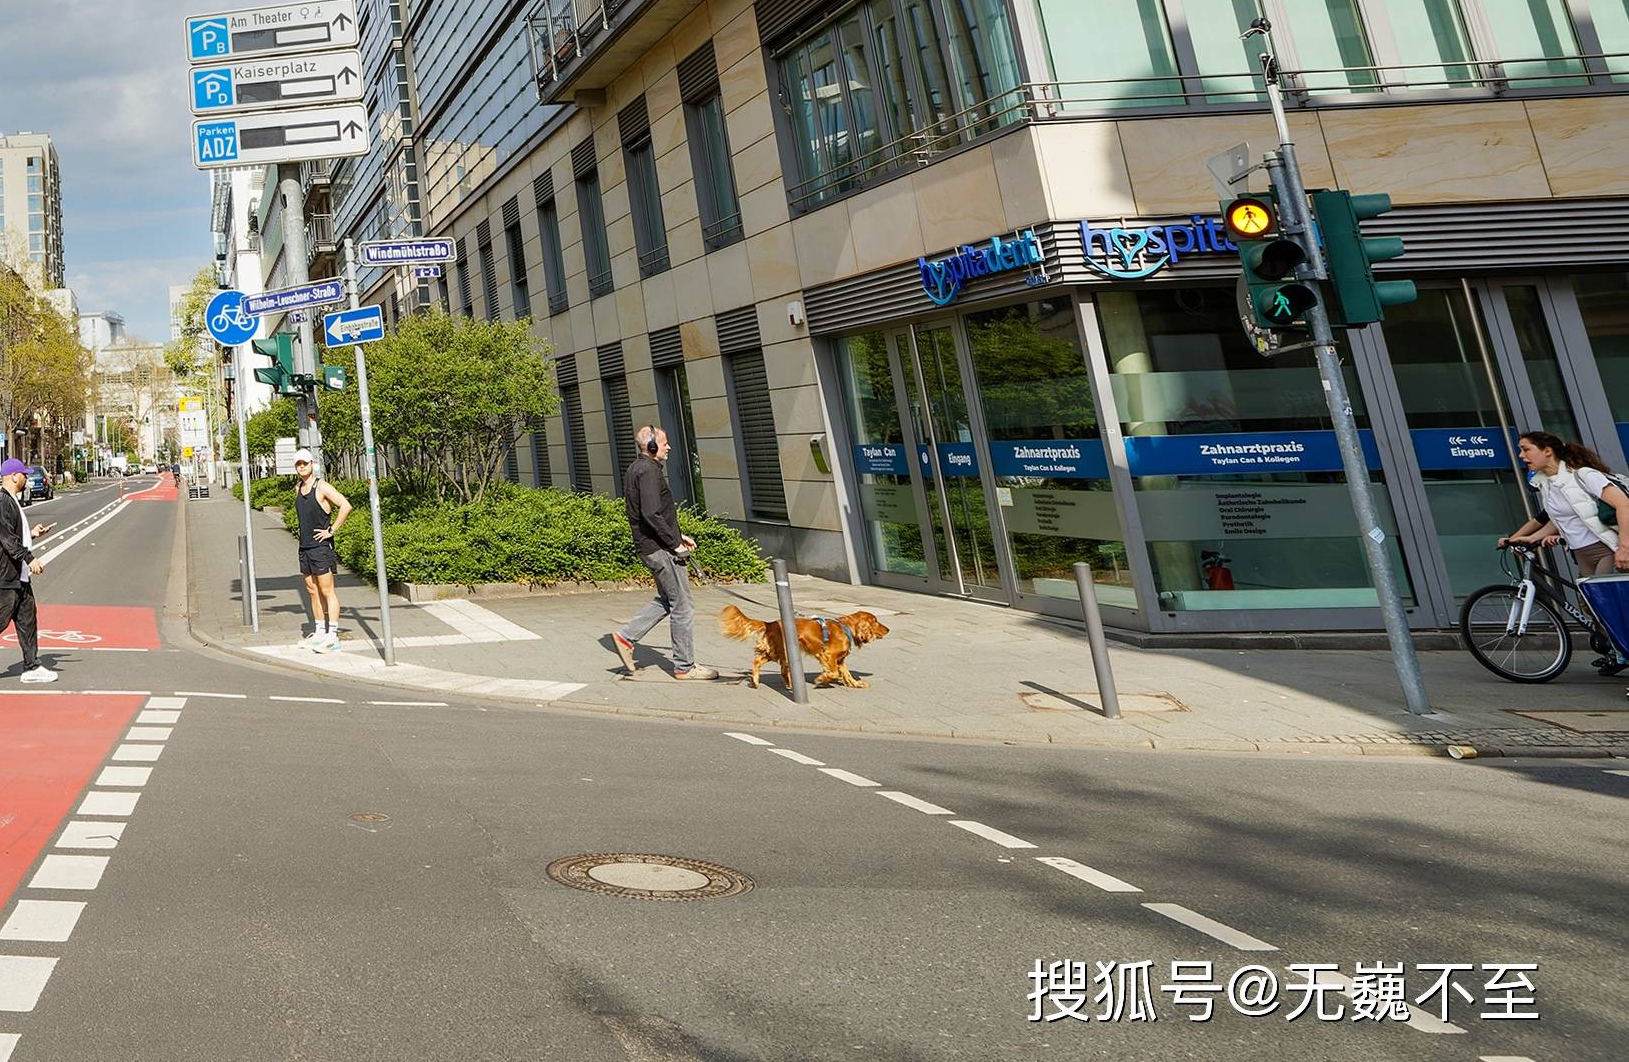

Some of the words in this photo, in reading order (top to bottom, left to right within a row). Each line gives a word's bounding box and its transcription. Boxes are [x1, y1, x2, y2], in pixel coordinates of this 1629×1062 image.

[231, 16, 247, 29] Am
[252, 11, 293, 26] Theater
[202, 30, 217, 51] P
[216, 41, 226, 54] B
[234, 61, 317, 80] Kaiserplatz
[205, 81, 220, 100] P
[218, 92, 228, 105] D
[199, 126, 235, 137] Parken
[201, 136, 236, 160] ADZ
[368, 244, 447, 260] Windmühlstraße
[249, 283, 337, 311] Wilhelm-Leuschner-Straße
[862, 447, 882, 458] Taylan
[884, 447, 896, 457] Can
[1013, 444, 1081, 461] Zahnarztpraxis
[1200, 441, 1304, 455] Zahnarztpraxis
[1450, 447, 1495, 459] Eingang
[948, 452, 971, 466] Eingang
[1211, 457, 1239, 465] Taylan
[1264, 456, 1300, 464] Kollegen
